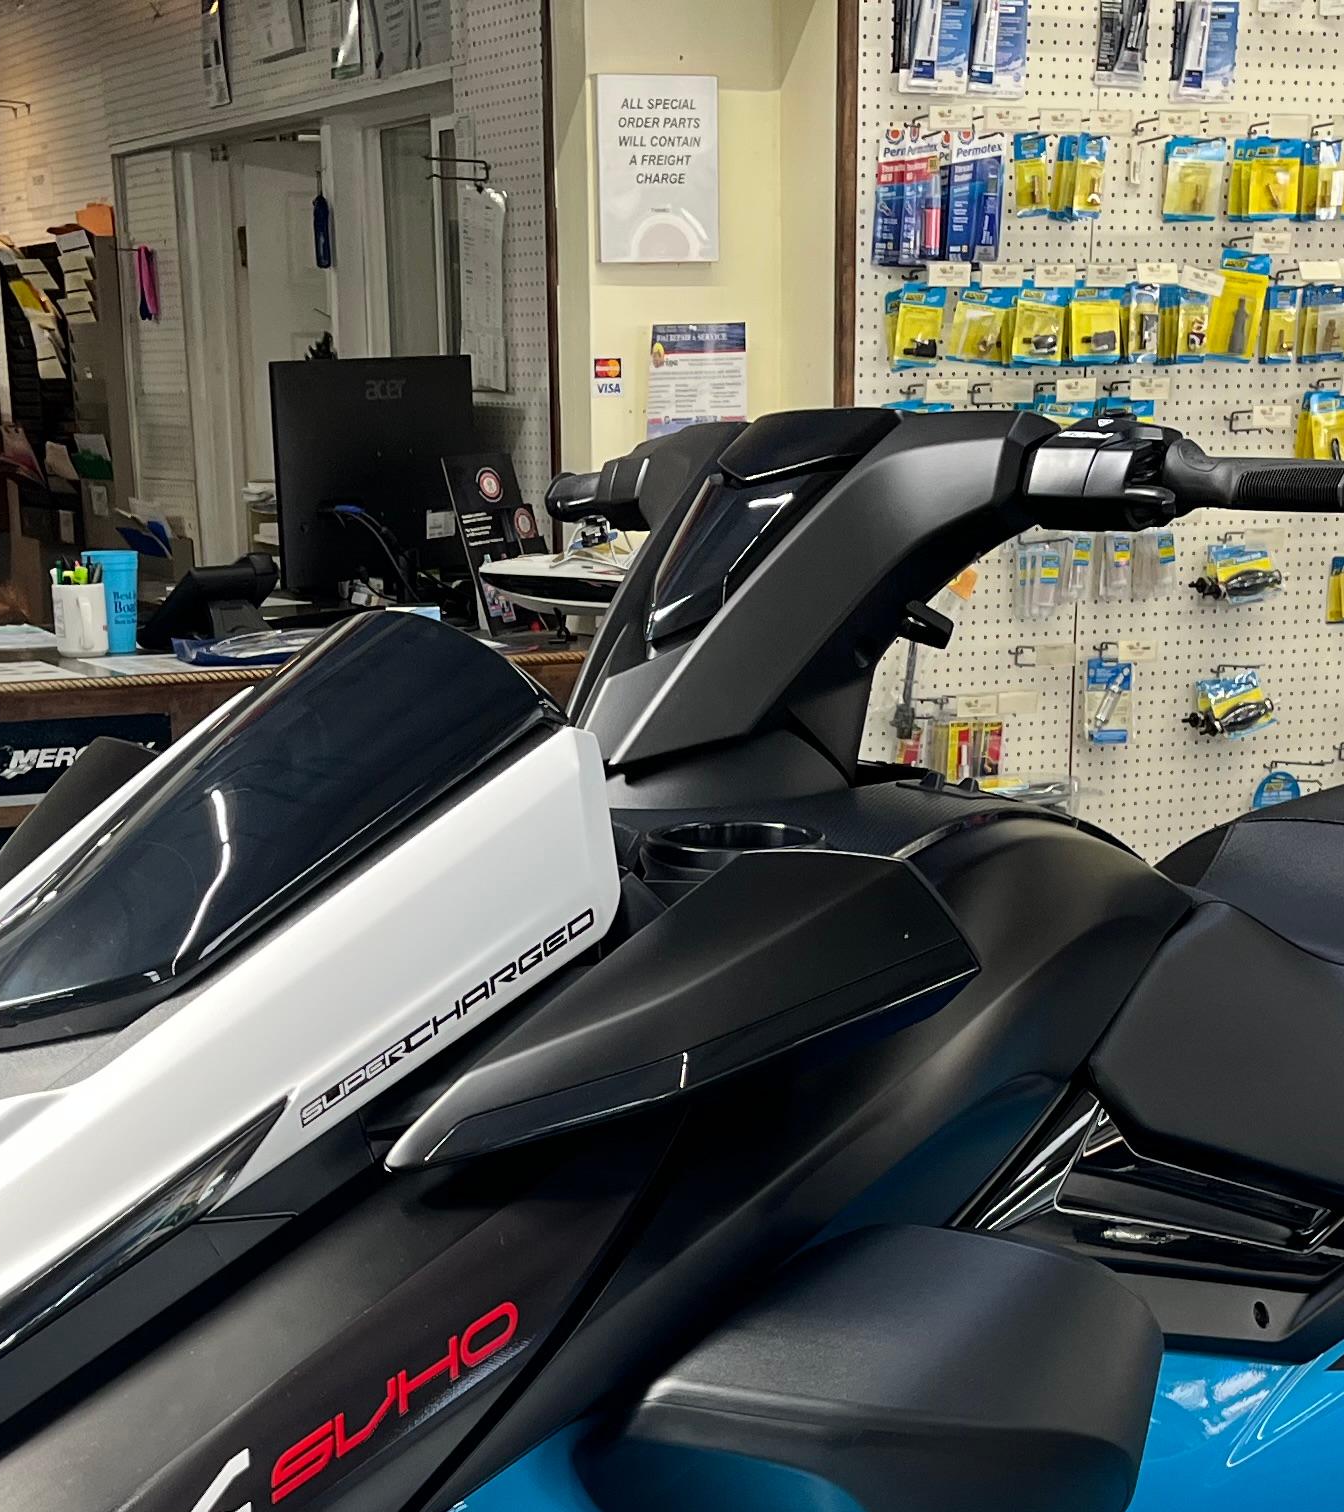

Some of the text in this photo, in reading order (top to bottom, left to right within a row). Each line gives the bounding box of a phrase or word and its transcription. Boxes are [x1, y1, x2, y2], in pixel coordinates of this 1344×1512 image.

[621, 98, 696, 110] ALL SPECIAL
[618, 117, 700, 129] ORDER PARTS
[618, 135, 702, 148] WILL CONTAIN
[956, 143, 1002, 158] Permatex
[629, 154, 692, 166] A FREIGHT
[636, 173, 686, 184] CHARGE
[697, 333, 728, 341] SERVICE
[366, 378, 406, 400] acer
[597, 383, 621, 394] VISA
[301, 907, 596, 1129] SUPERCHARGED
[270, 1301, 520, 1504] SVHO
